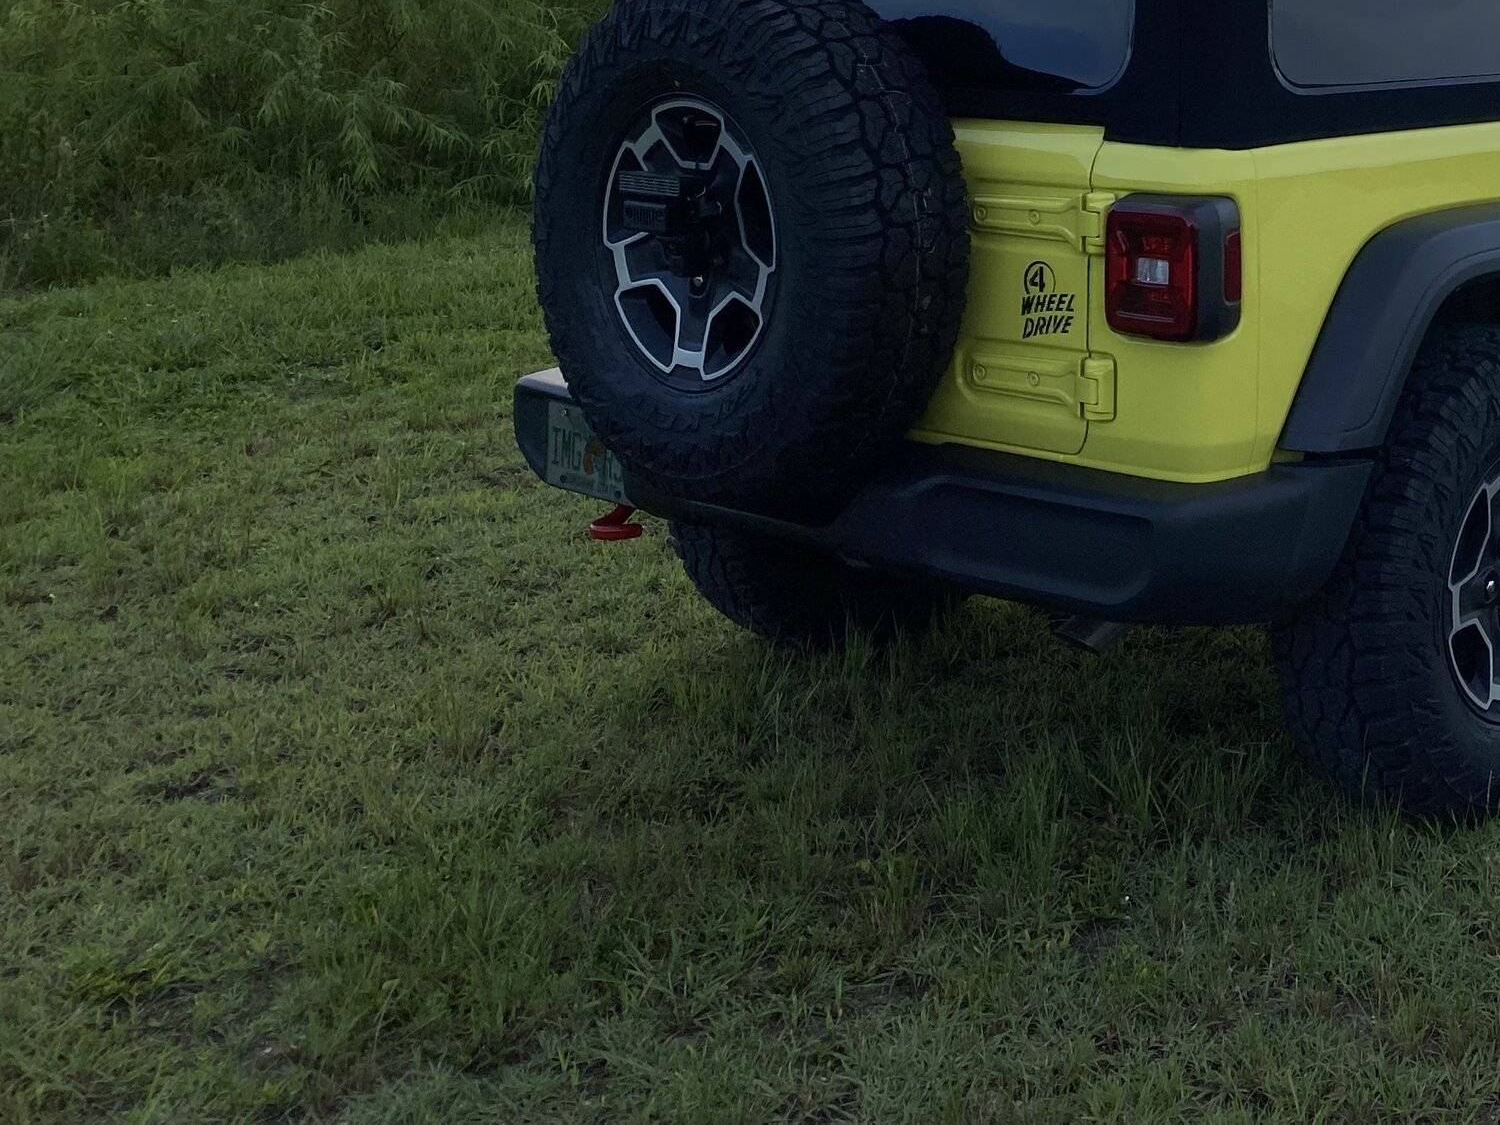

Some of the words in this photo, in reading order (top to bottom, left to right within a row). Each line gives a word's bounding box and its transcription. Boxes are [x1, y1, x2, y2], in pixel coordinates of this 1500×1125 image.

[1028, 266, 1046, 293] 4
[1021, 293, 1075, 316] WHEEL
[1022, 315, 1074, 339] DRIVE
